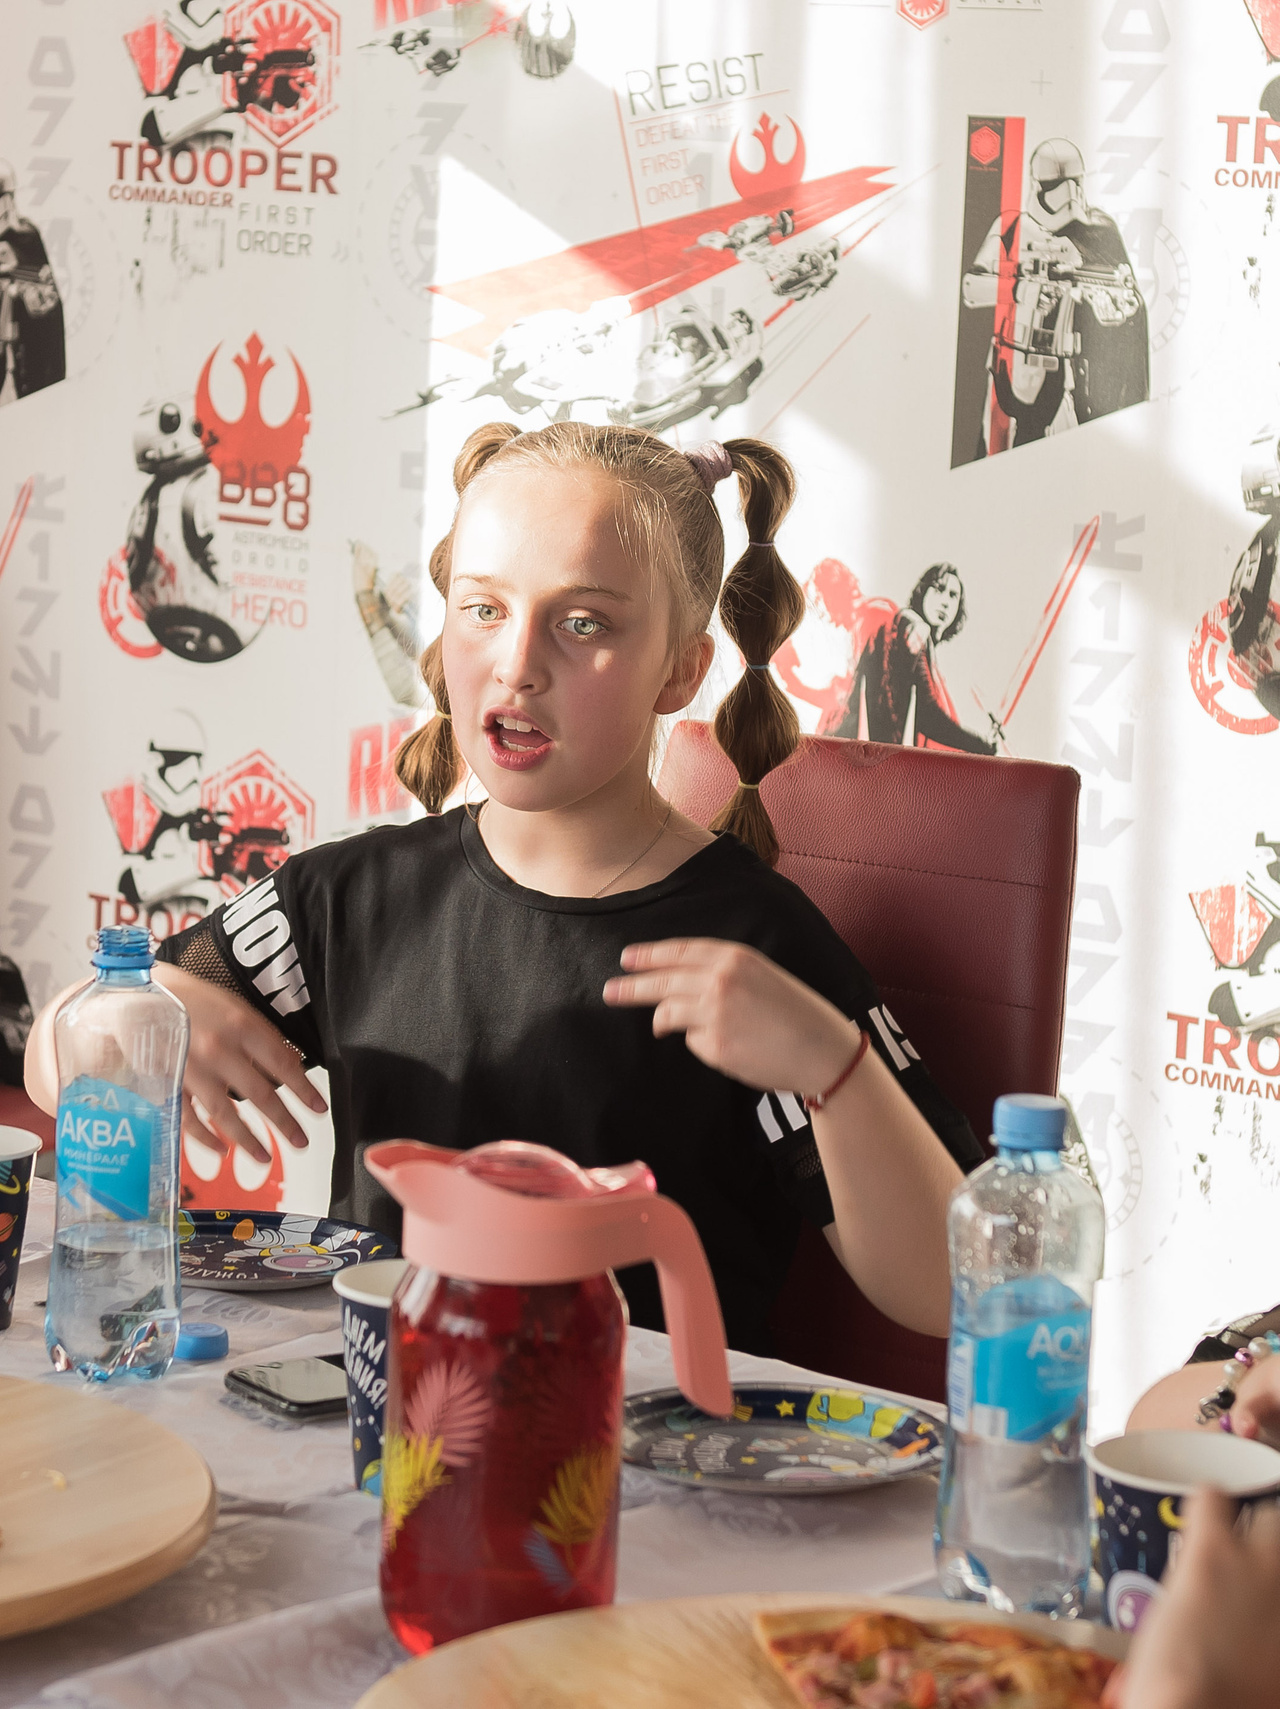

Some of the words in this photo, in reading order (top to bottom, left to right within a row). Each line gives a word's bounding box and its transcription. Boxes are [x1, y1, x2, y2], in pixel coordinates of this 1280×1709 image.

[625, 52, 764, 116] RESIST
[634, 115, 702, 148] DEFEAT
[110, 140, 339, 195] TROOPER
[639, 148, 690, 177] FIRST
[1214, 167, 1280, 190] COM
[109, 184, 235, 208] COMMANDER
[645, 173, 706, 206] ORDER
[238, 202, 315, 227] FIRST
[236, 228, 313, 257] ORDER
[219, 459, 311, 531] BB8
[230, 591, 309, 630] HERO
[61, 1110, 137, 1150] АКВА
